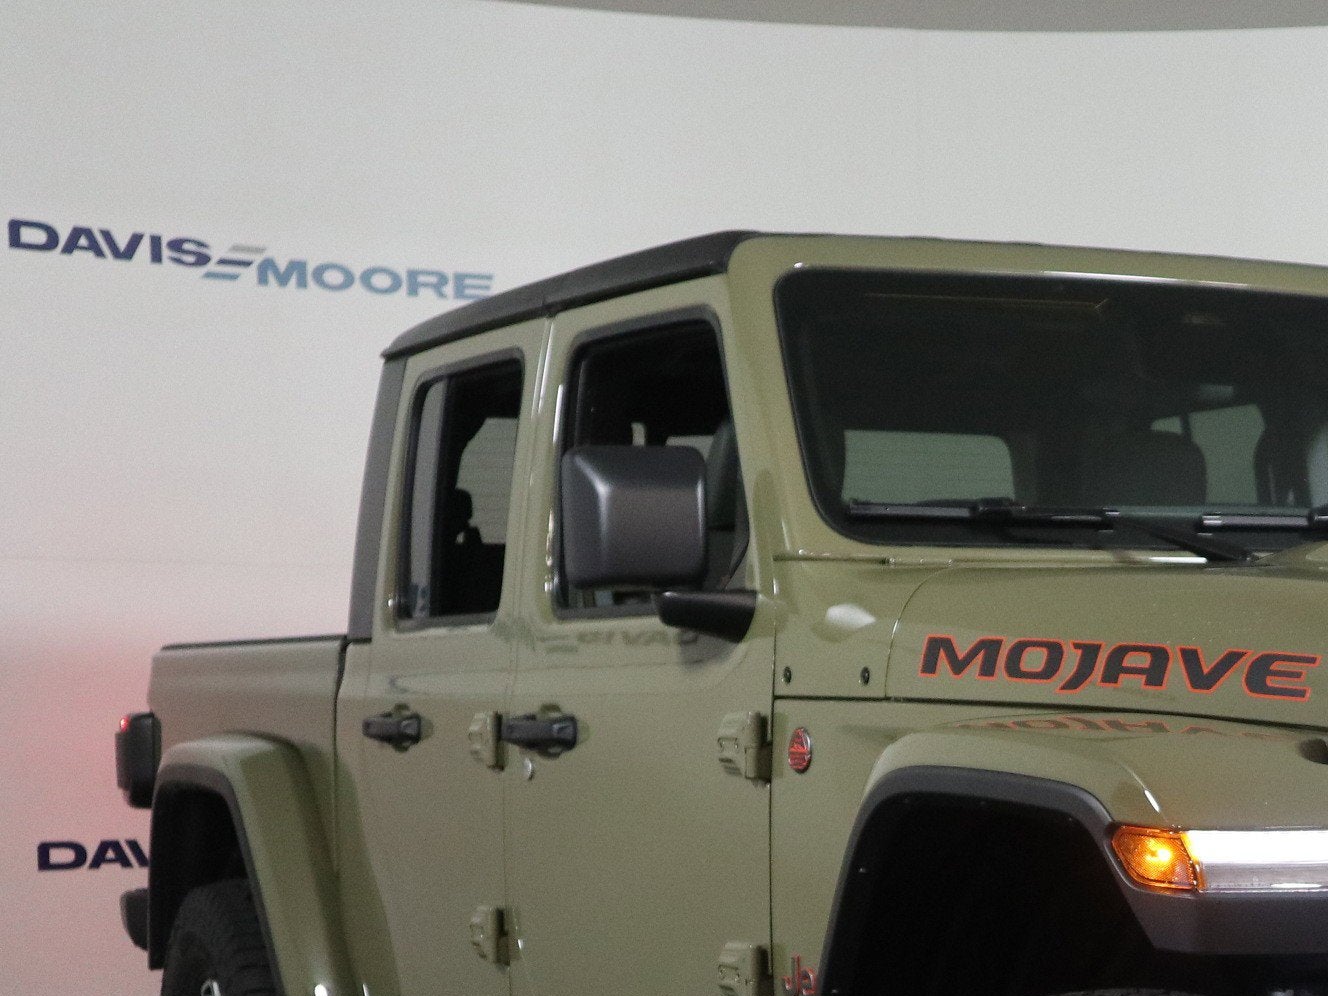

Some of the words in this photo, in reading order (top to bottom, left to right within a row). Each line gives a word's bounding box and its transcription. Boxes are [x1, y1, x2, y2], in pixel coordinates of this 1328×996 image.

[8, 218, 212, 267] DAVIS
[257, 257, 494, 300] MOORE
[915, 633, 1323, 702] MOJAVE
